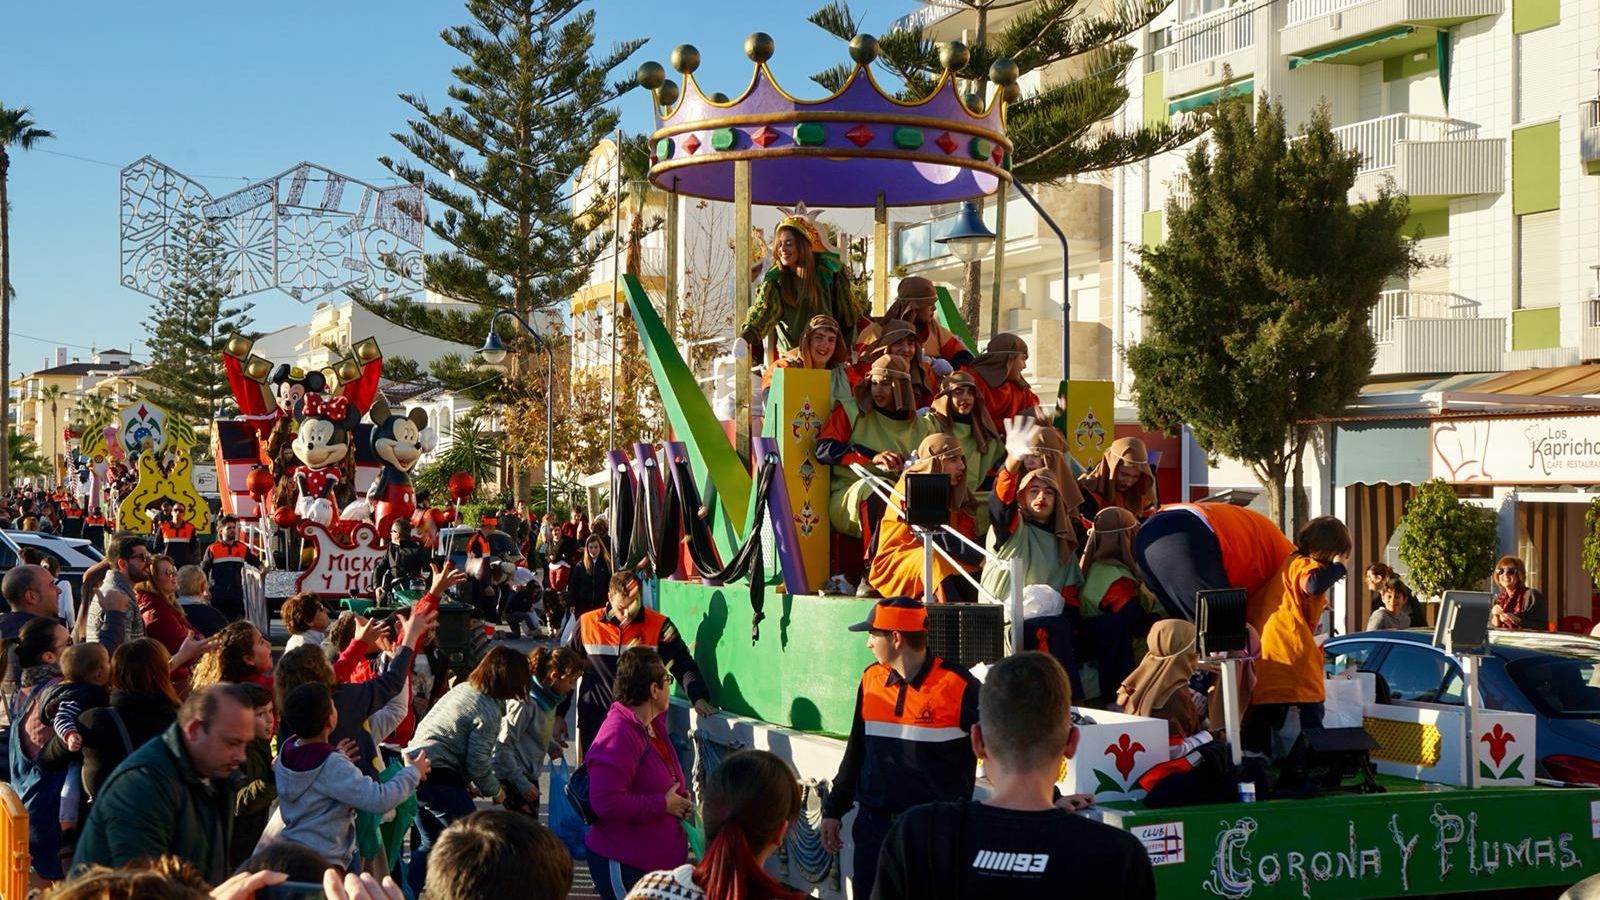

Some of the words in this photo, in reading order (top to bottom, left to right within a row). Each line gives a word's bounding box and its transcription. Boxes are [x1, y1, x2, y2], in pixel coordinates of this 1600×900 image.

[1548, 427, 1567, 440] Los
[1142, 827, 1165, 839] CLUB
[1389, 813, 1420, 892] Y
